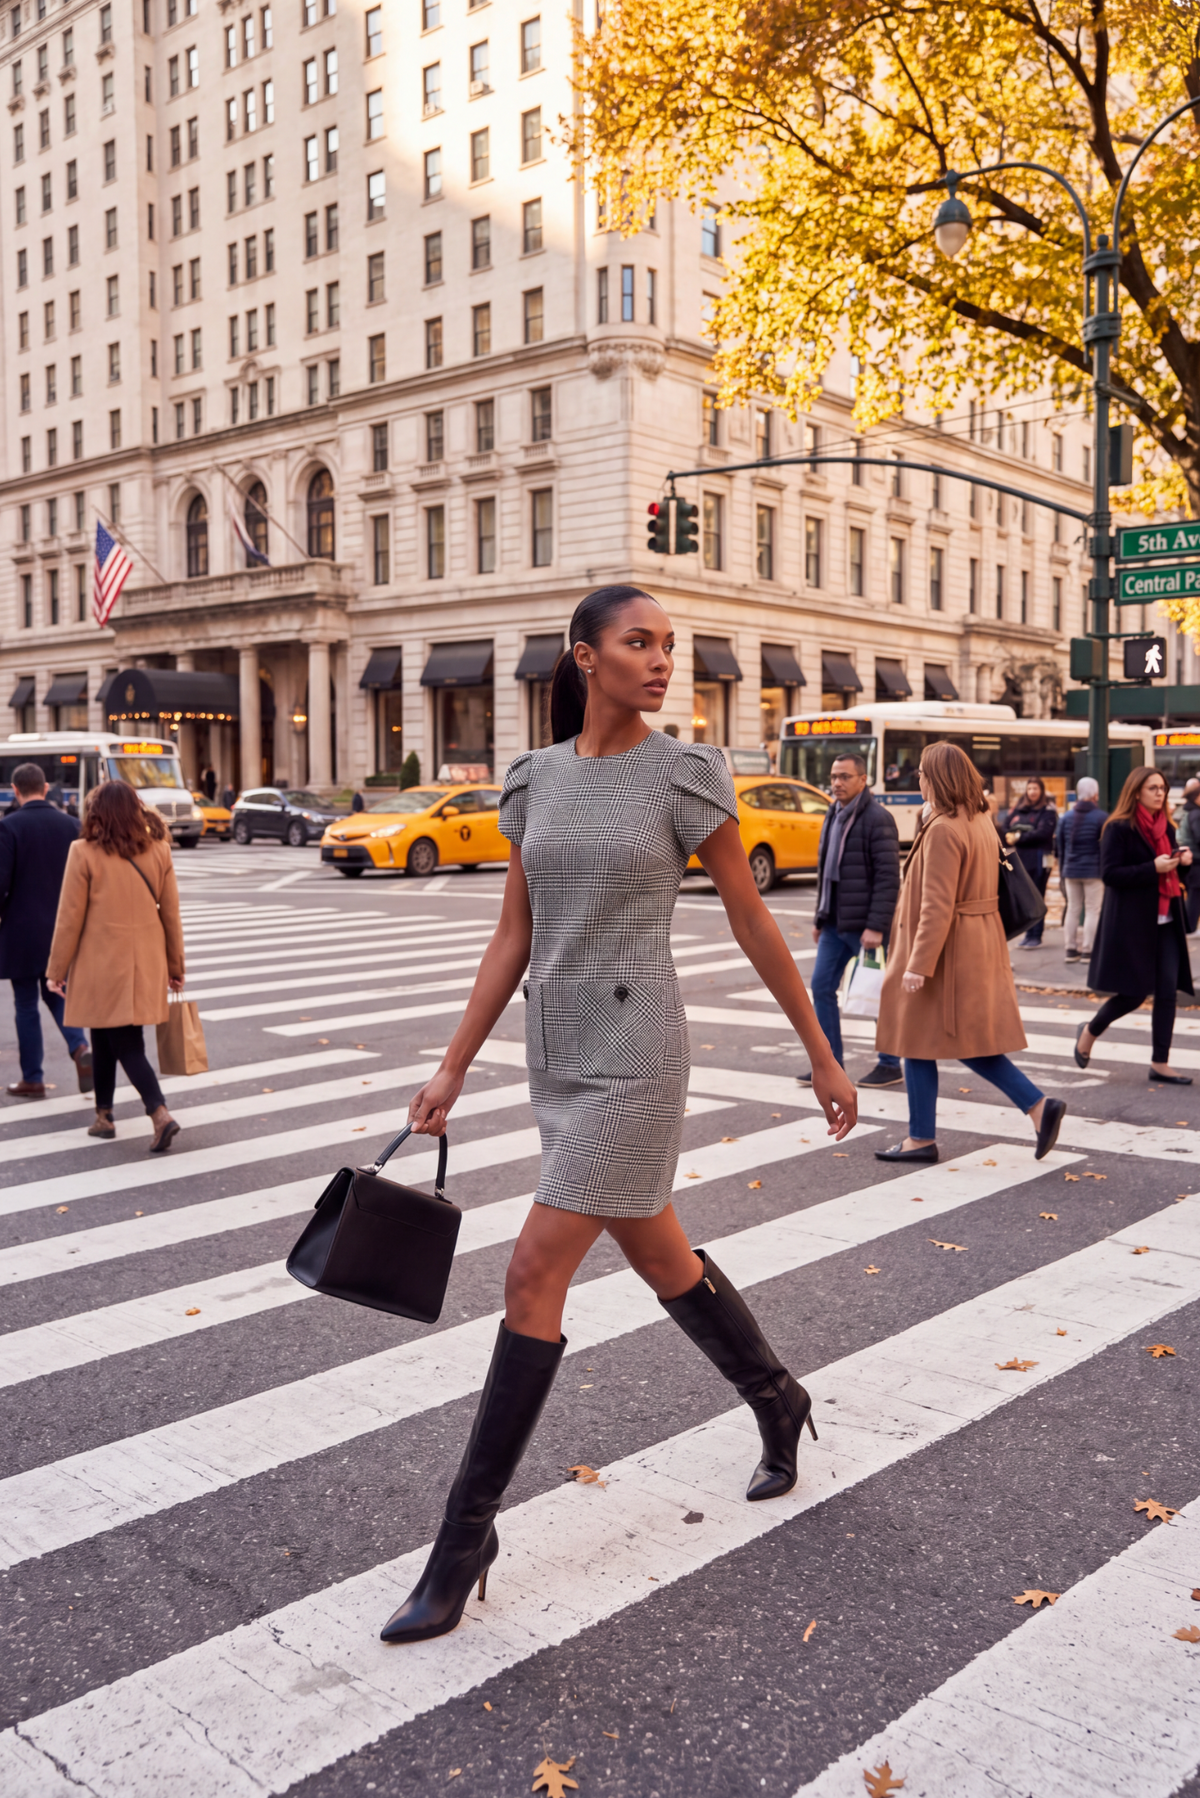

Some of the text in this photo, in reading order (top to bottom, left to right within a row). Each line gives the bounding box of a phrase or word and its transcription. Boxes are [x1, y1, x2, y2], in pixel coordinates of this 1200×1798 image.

[1138, 530, 1200, 553] 5th Av
[1125, 571, 1180, 595] Central
